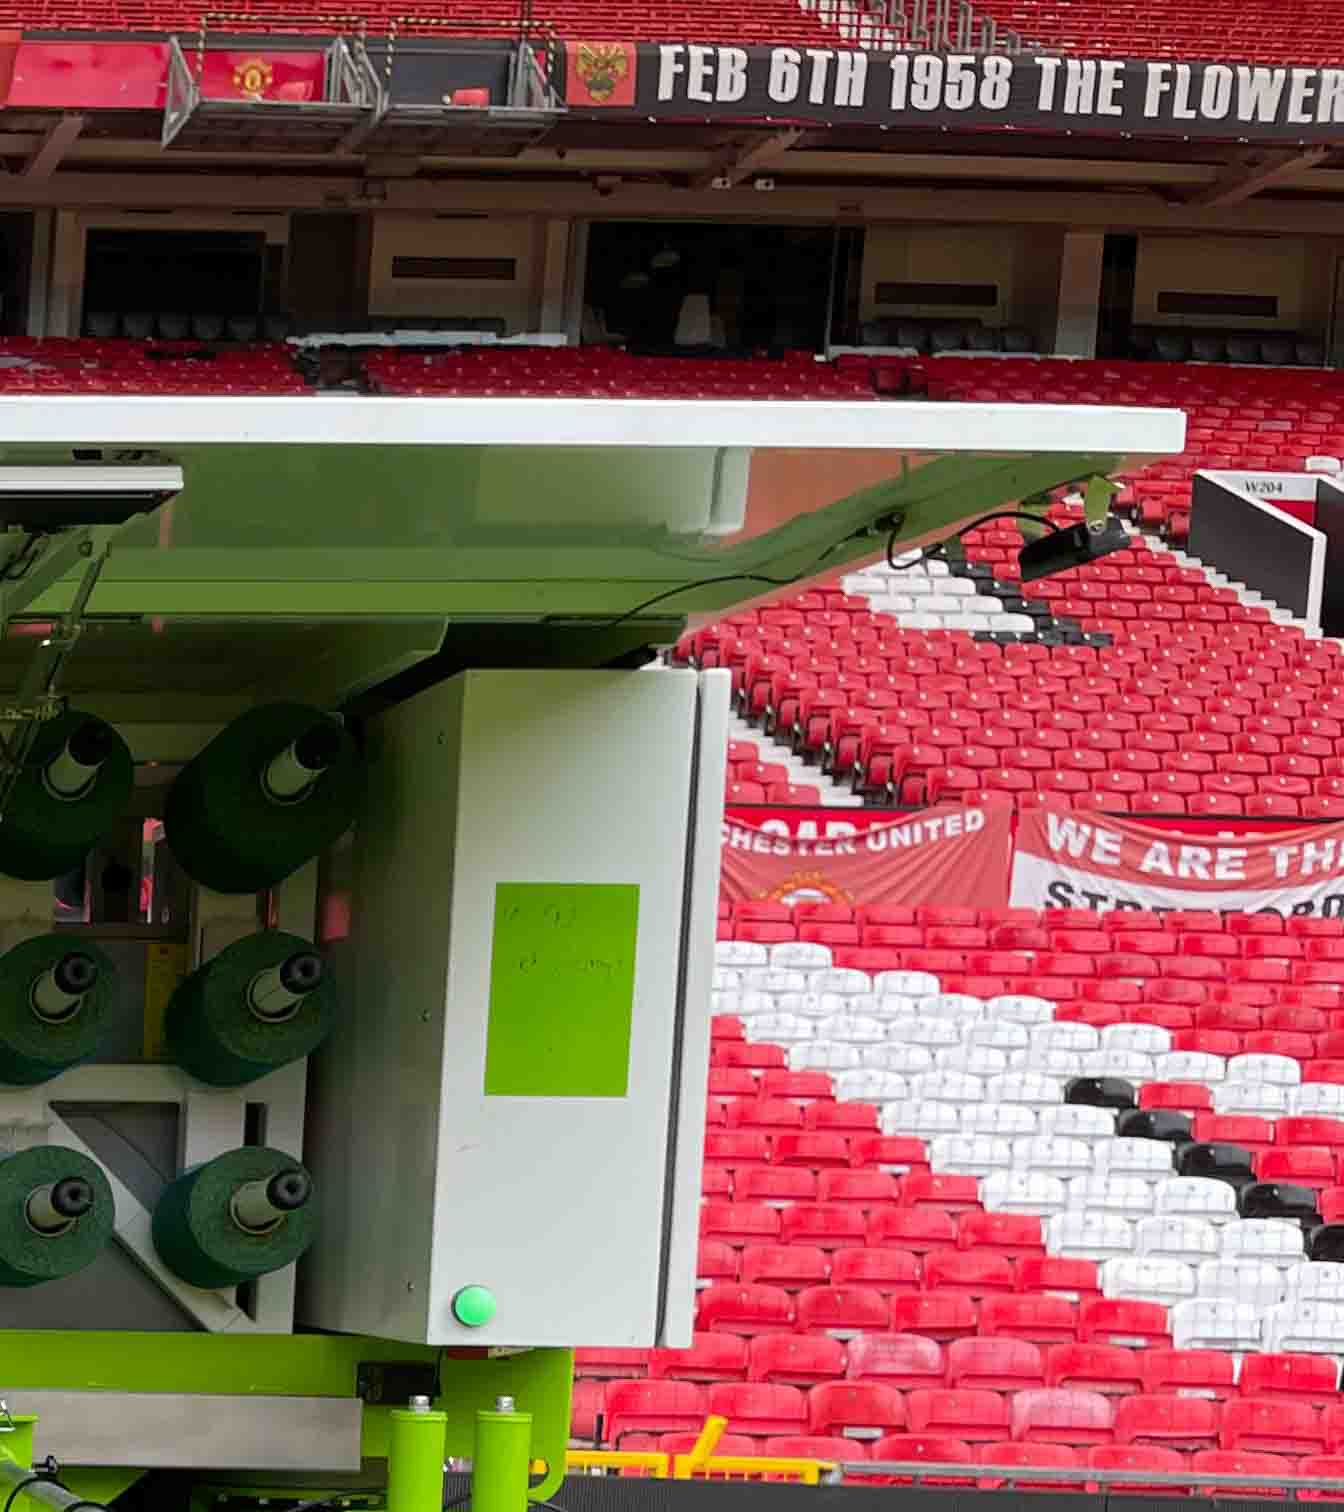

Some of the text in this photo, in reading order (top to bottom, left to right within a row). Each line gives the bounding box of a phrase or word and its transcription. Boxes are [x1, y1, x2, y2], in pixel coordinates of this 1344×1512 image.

[657, 44, 1344, 124] FEB 6TH 1958 THE FLOWER
[1244, 480, 1284, 495] W204
[865, 808, 986, 852] UNITED
[1046, 812, 1344, 880] WE ARE TH
